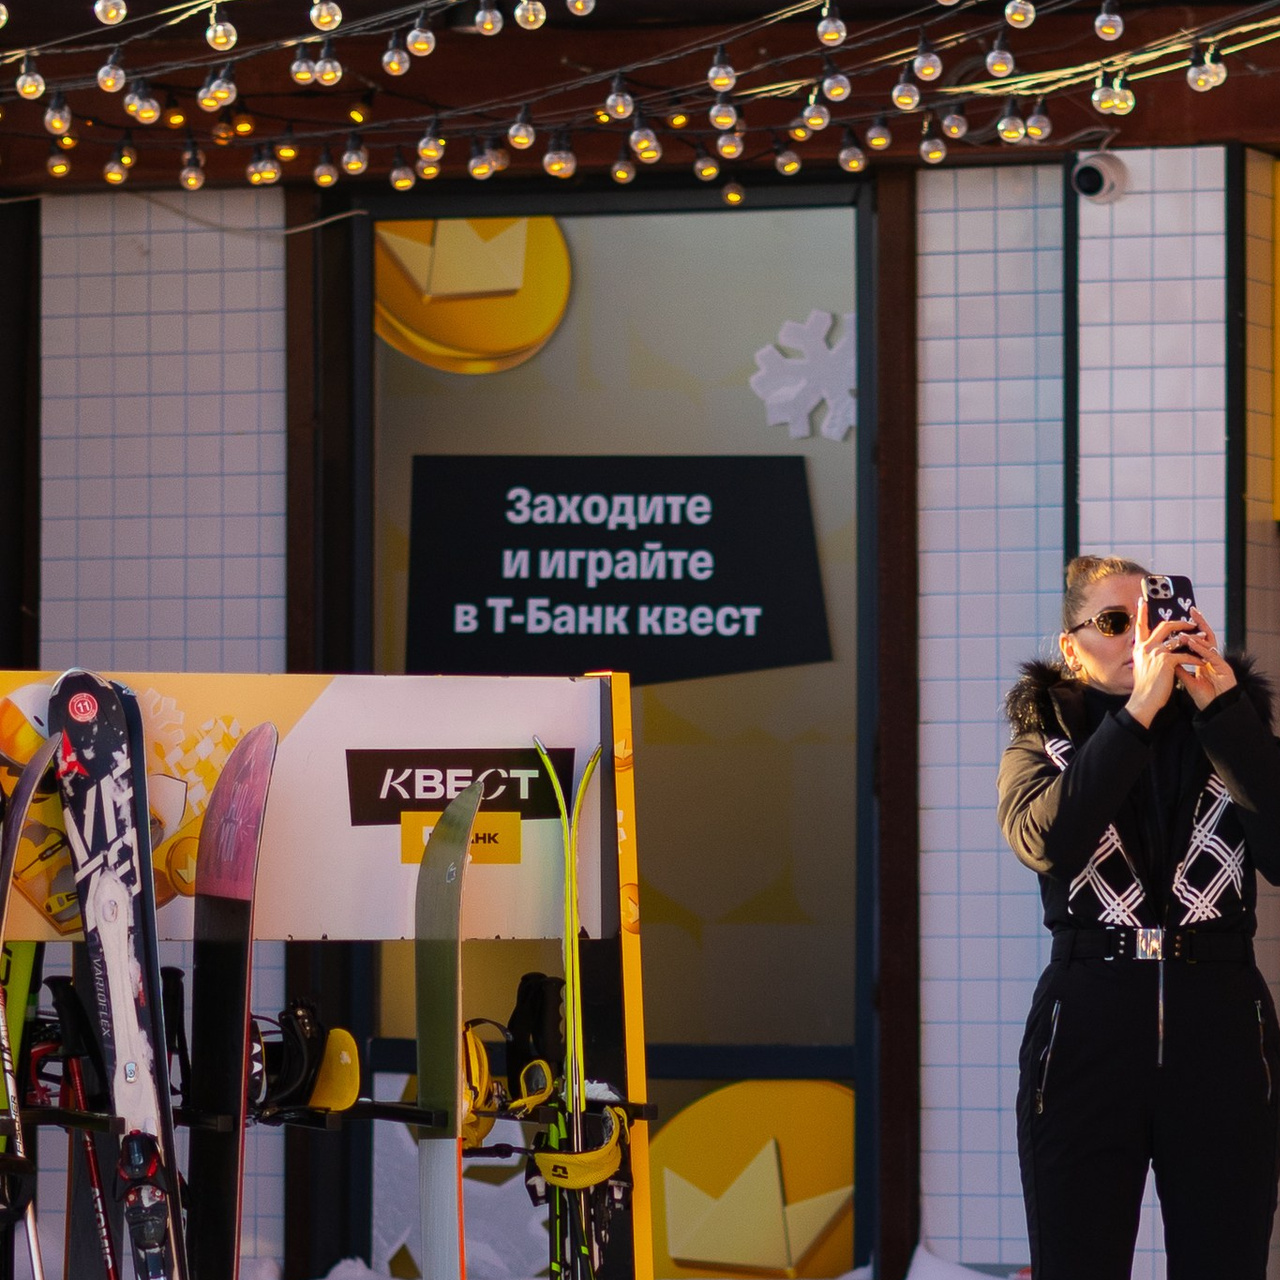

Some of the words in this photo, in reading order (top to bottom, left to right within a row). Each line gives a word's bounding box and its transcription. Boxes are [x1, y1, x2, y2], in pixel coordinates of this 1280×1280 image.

[505, 487, 713, 530] Заходите
[502, 549, 530, 579] и
[539, 541, 714, 588] играйте
[454, 604, 479, 634] в
[487, 596, 630, 635] Т-Банк
[638, 606, 762, 636] квест
